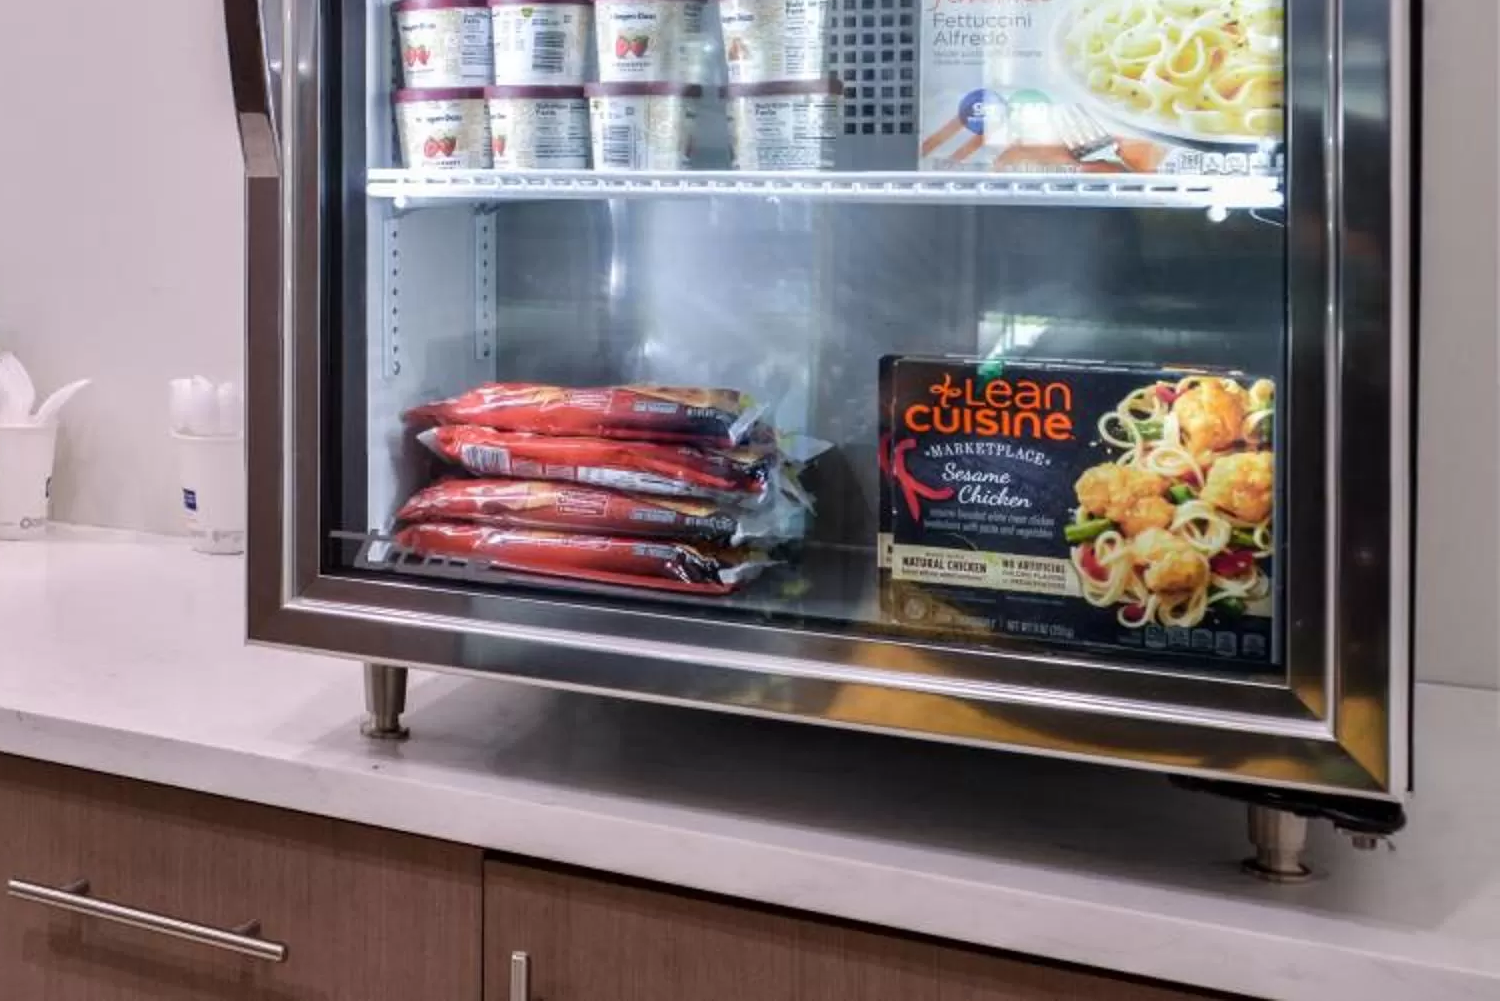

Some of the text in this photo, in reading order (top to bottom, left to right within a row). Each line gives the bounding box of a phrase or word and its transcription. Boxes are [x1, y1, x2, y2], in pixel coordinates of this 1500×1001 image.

[933, 12, 1032, 28] Fettuccini
[933, 30, 1009, 46] Alfredo
[965, 378, 1072, 411] Lean
[931, 442, 1045, 466] MARKETPLACE
[942, 463, 1012, 484] Sesame
[958, 485, 1033, 508] Chicken
[902, 556, 987, 573] NATURAL CHICKEN
